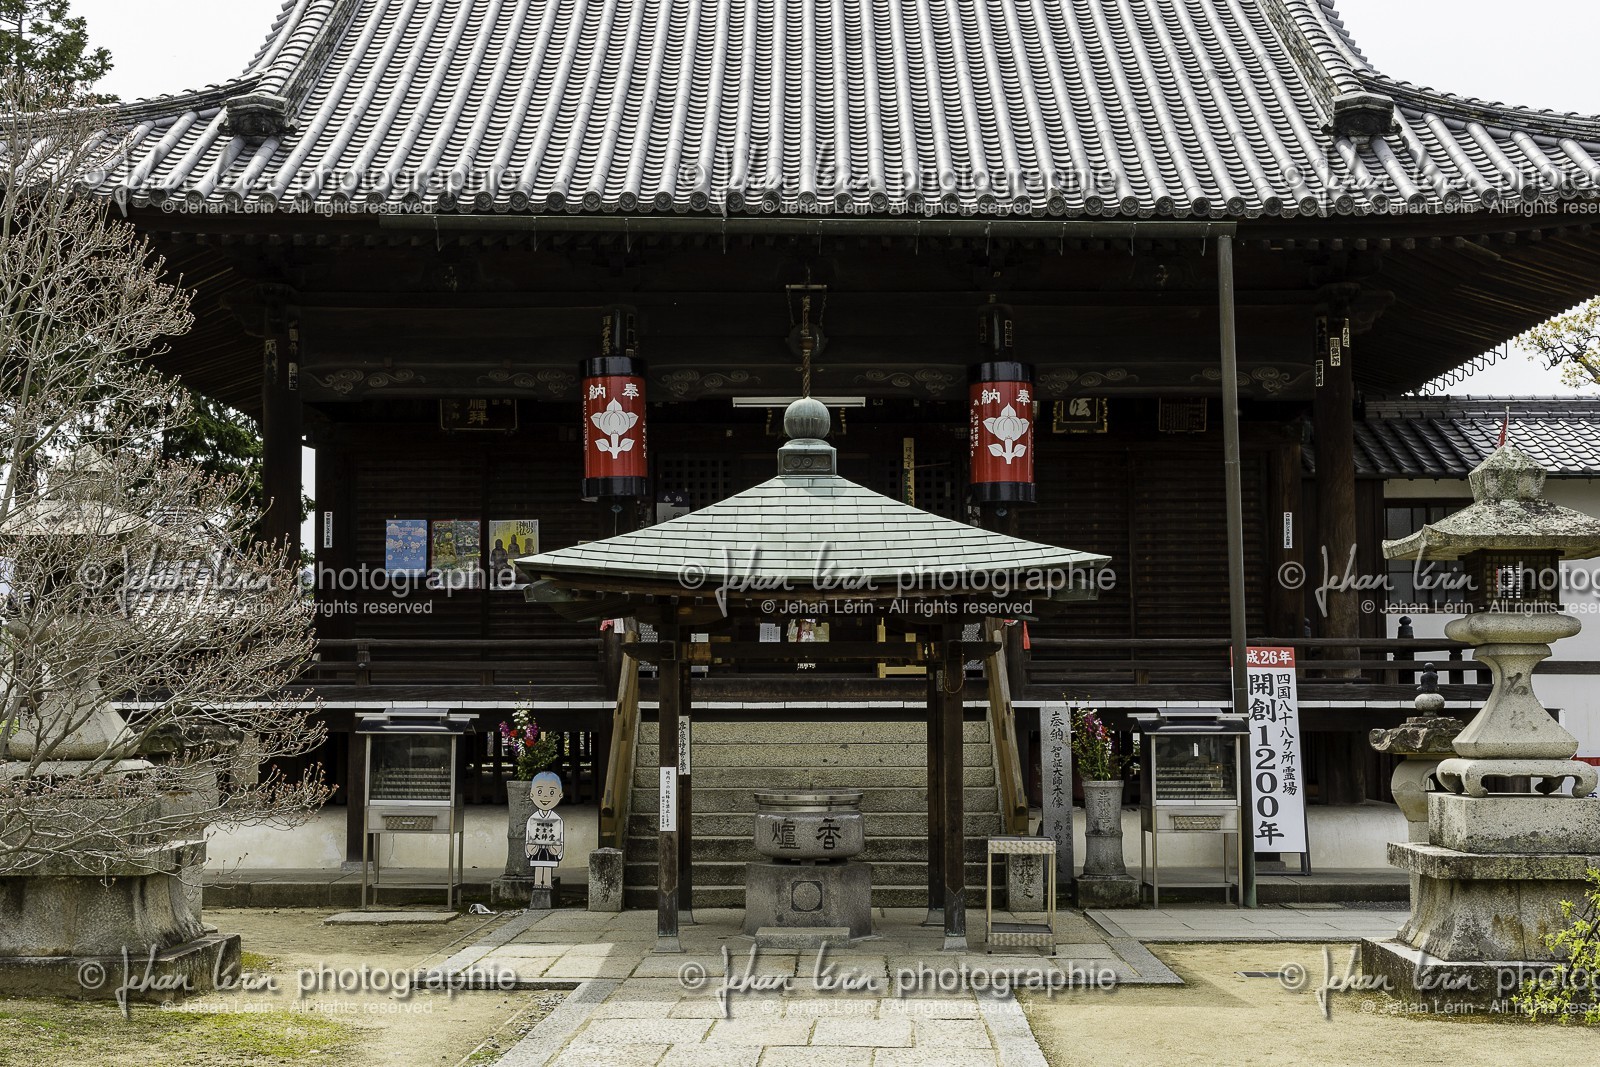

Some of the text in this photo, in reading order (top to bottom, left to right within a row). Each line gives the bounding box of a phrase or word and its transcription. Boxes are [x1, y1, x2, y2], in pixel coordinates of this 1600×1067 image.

[590, 383, 640, 401] 奉納
[982, 389, 1031, 405] 奉納
[1246, 651, 1293, 665] 成26年
[1248, 673, 1284, 846] 開創1200年
[533, 833, 555, 842] 大師堂
